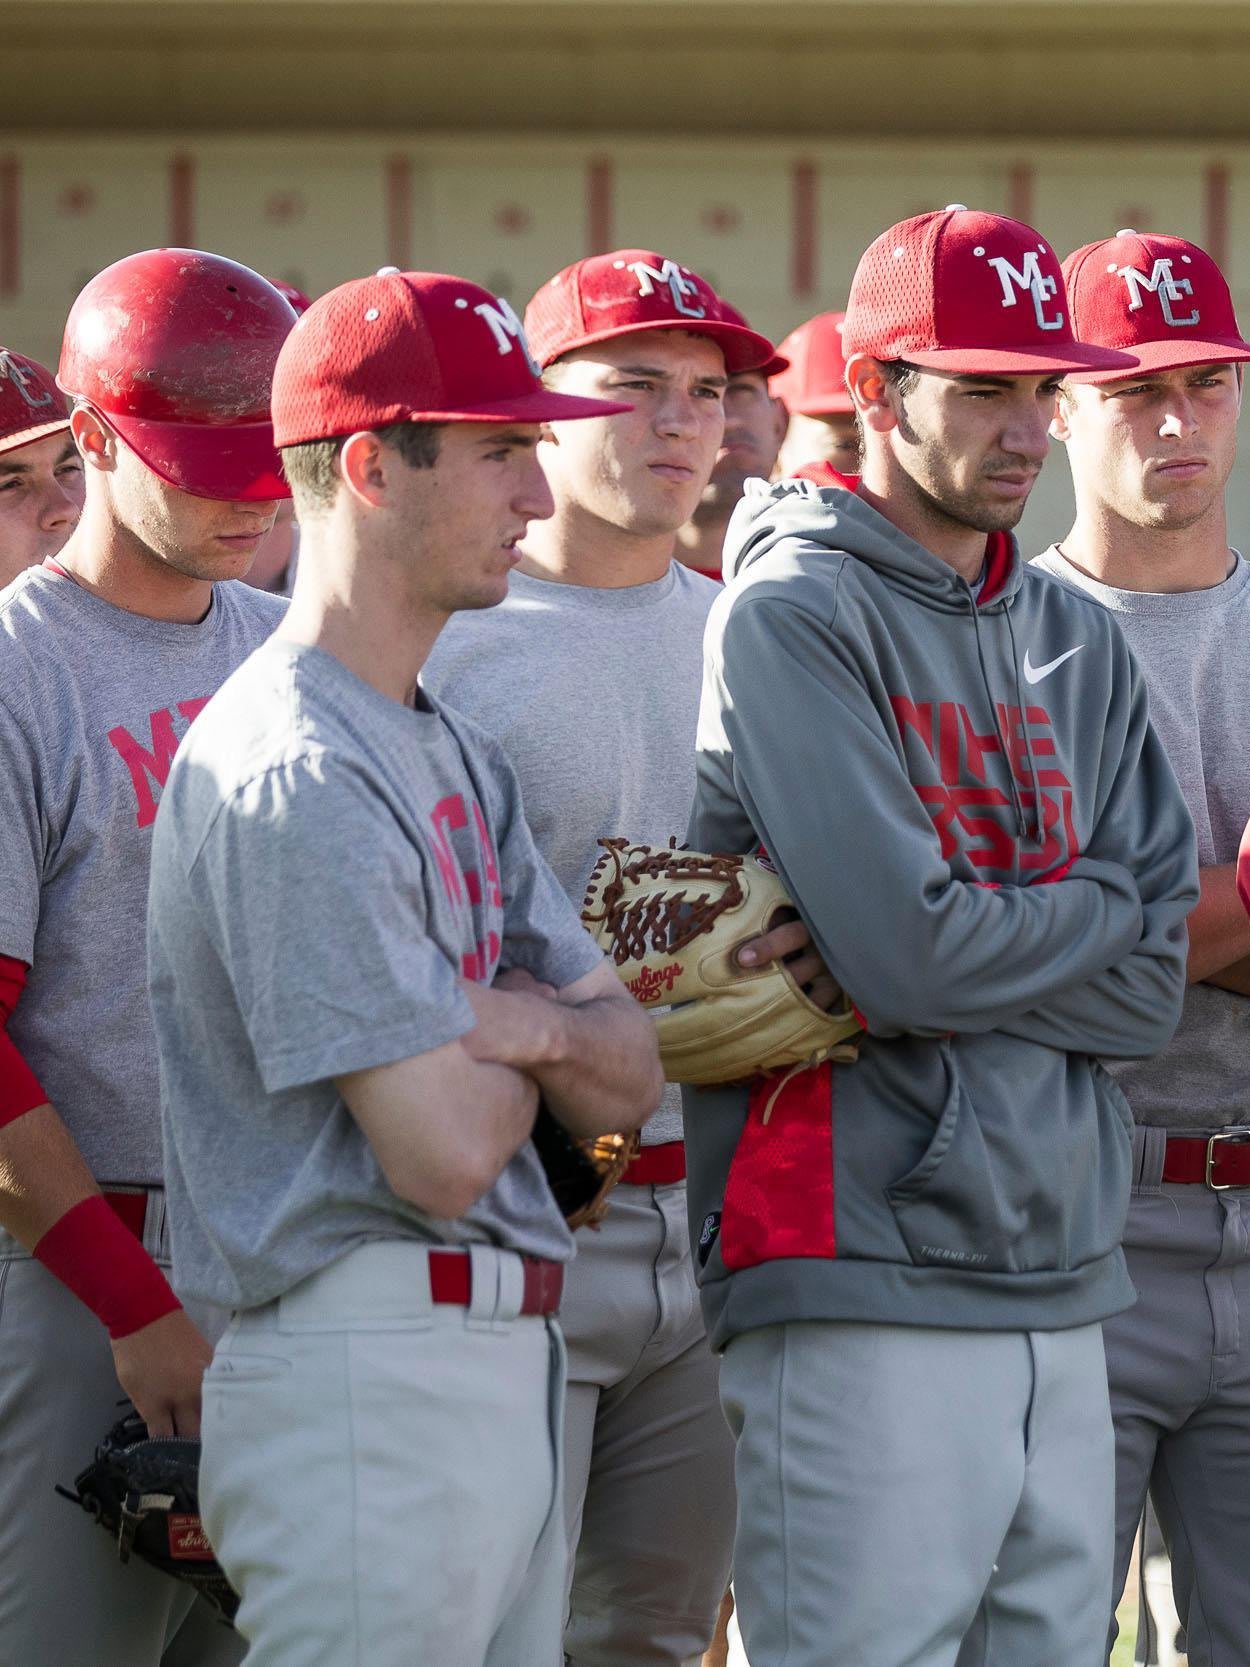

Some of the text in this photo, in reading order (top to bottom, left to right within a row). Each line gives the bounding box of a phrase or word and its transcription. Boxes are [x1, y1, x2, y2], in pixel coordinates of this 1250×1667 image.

[626, 259, 706, 318] MC
[987, 252, 1064, 330] MC
[1117, 258, 1200, 326] MC
